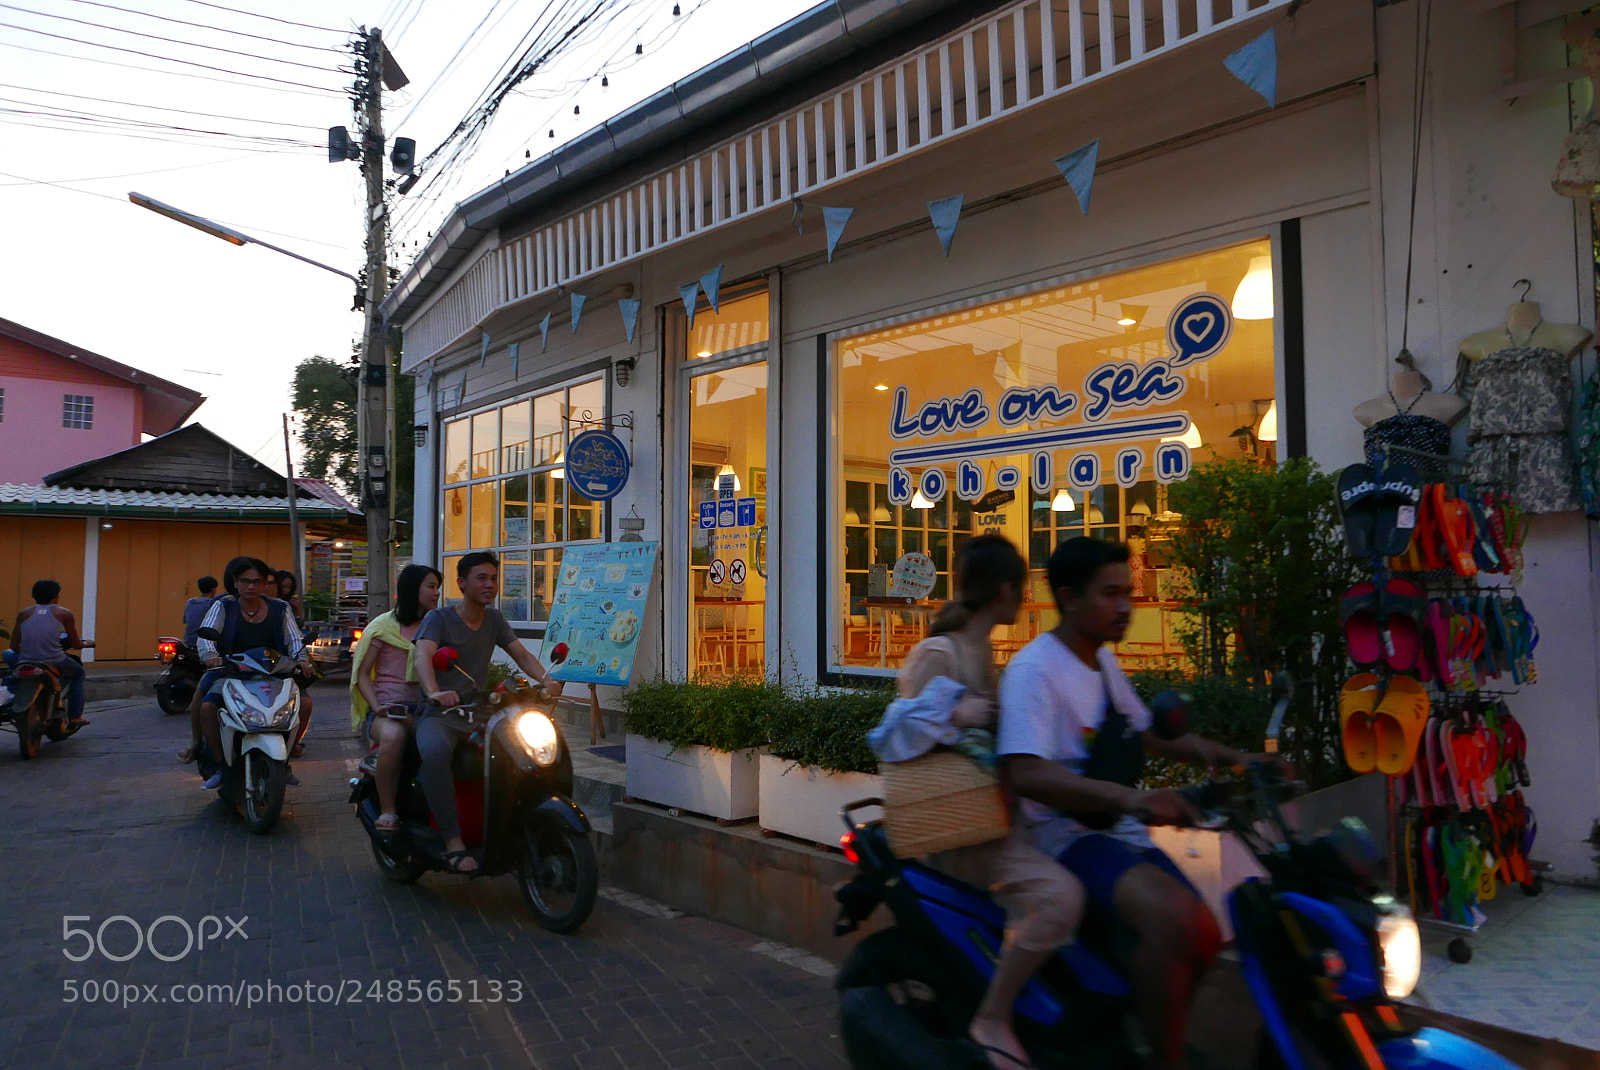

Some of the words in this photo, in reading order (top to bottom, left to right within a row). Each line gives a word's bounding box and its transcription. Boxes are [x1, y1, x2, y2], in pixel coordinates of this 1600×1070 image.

[890, 385, 990, 439] Love
[998, 384, 1076, 426] on
[719, 489, 734, 499] OPEN
[978, 514, 1006, 526] LOVE
